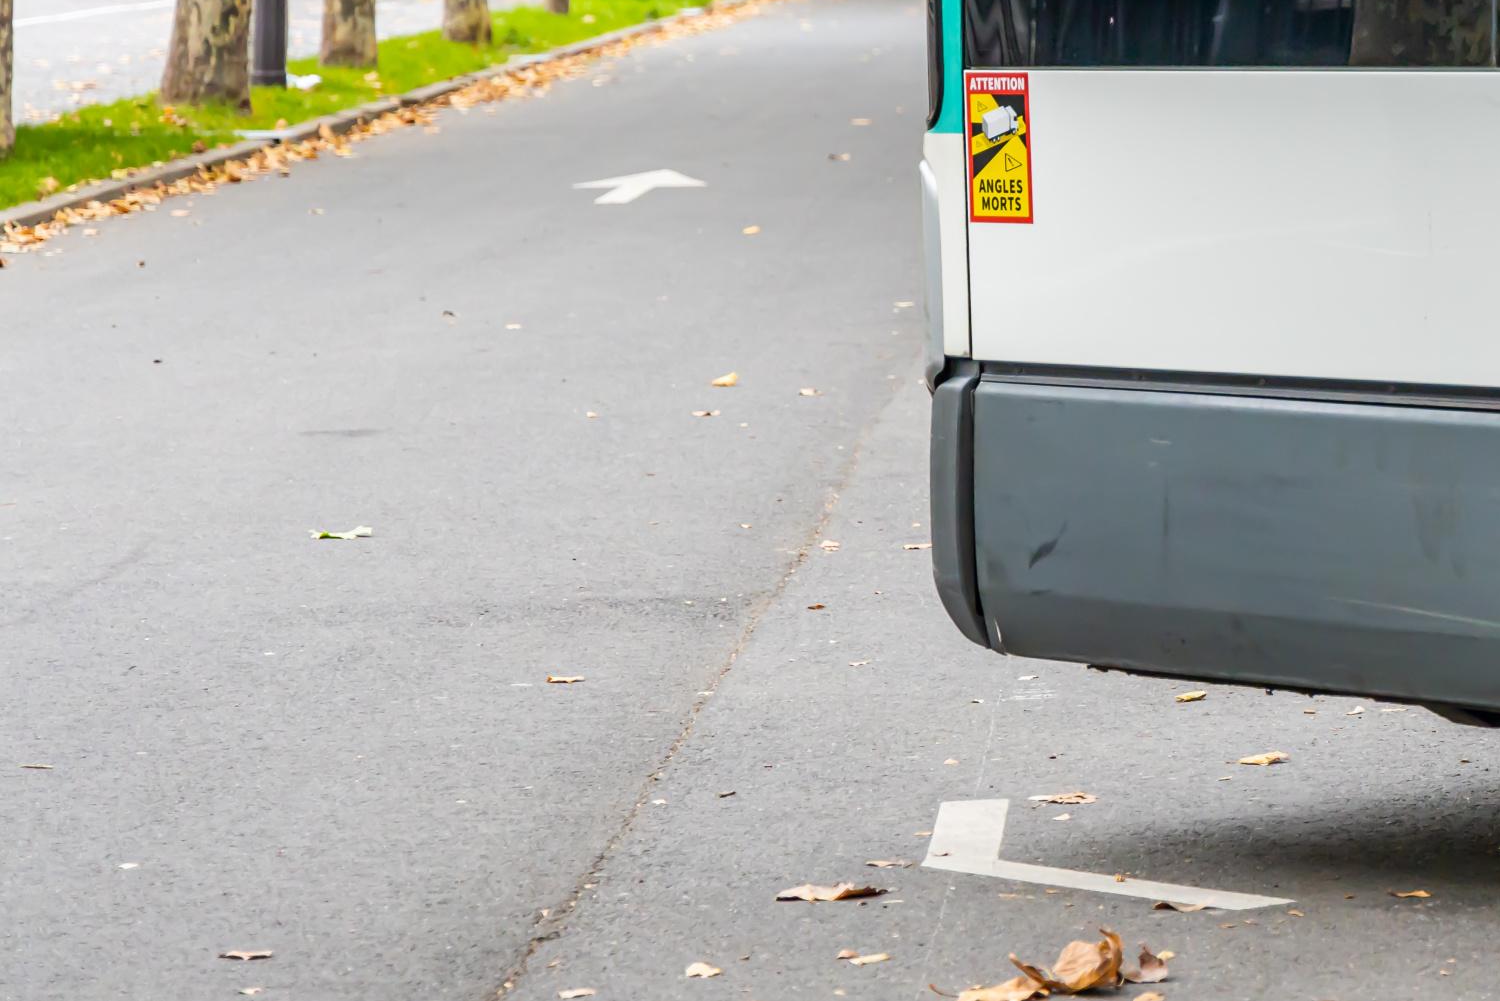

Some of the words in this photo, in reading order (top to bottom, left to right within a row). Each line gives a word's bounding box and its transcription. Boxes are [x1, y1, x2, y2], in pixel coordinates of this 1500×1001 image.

[969, 77, 1025, 91] ATTENTION
[979, 178, 1023, 194] ANGLES
[982, 196, 1022, 211] MORTS
